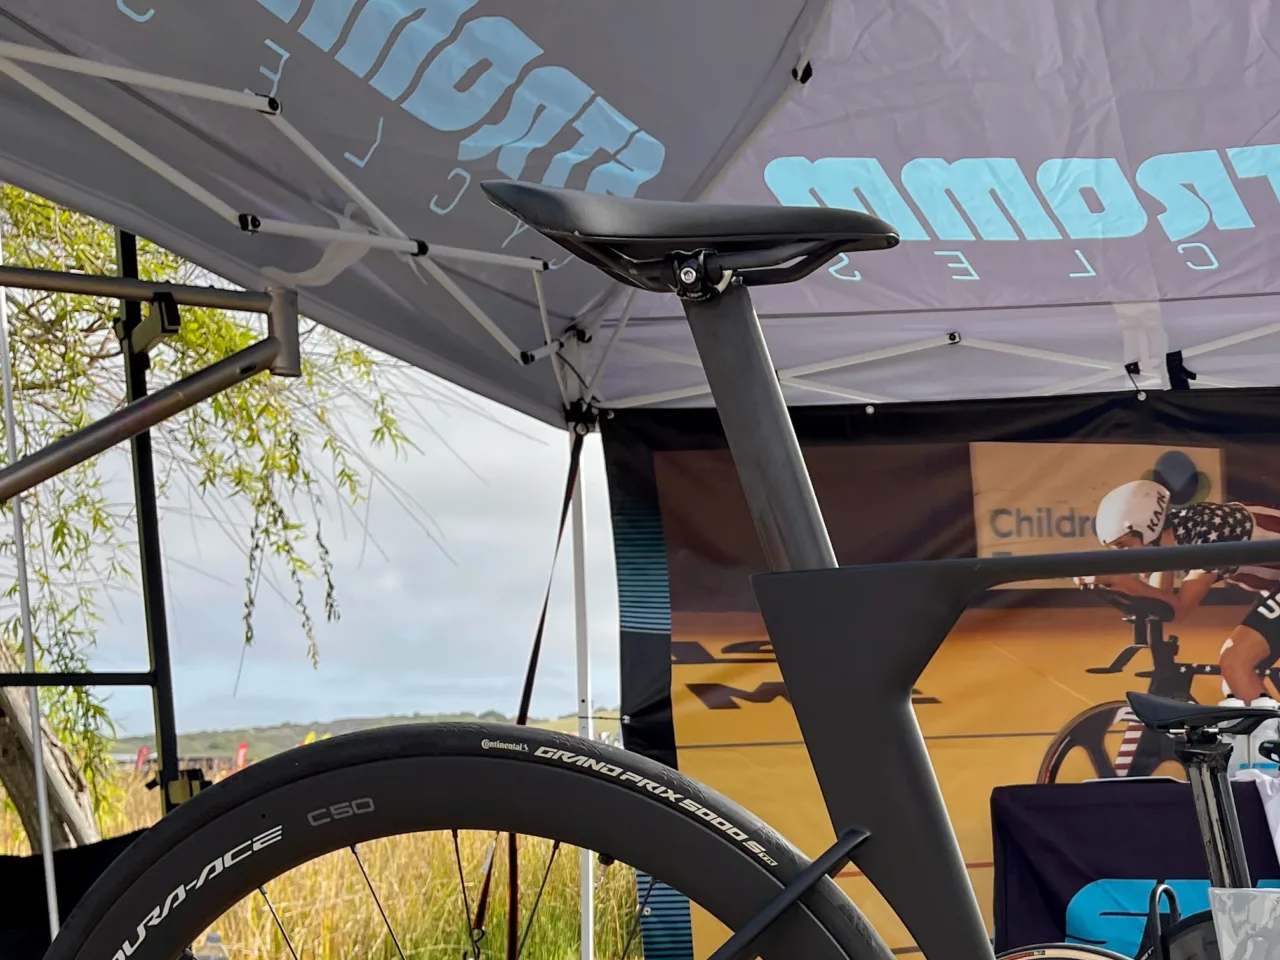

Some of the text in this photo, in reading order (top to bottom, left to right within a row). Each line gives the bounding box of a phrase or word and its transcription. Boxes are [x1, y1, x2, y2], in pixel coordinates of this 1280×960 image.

[307, 797, 375, 827] C50
[481, 738, 523, 752] Continental
[534, 746, 623, 777] GRAND
[619, 770, 684, 803] PRIX
[678, 798, 750, 841] 5000
